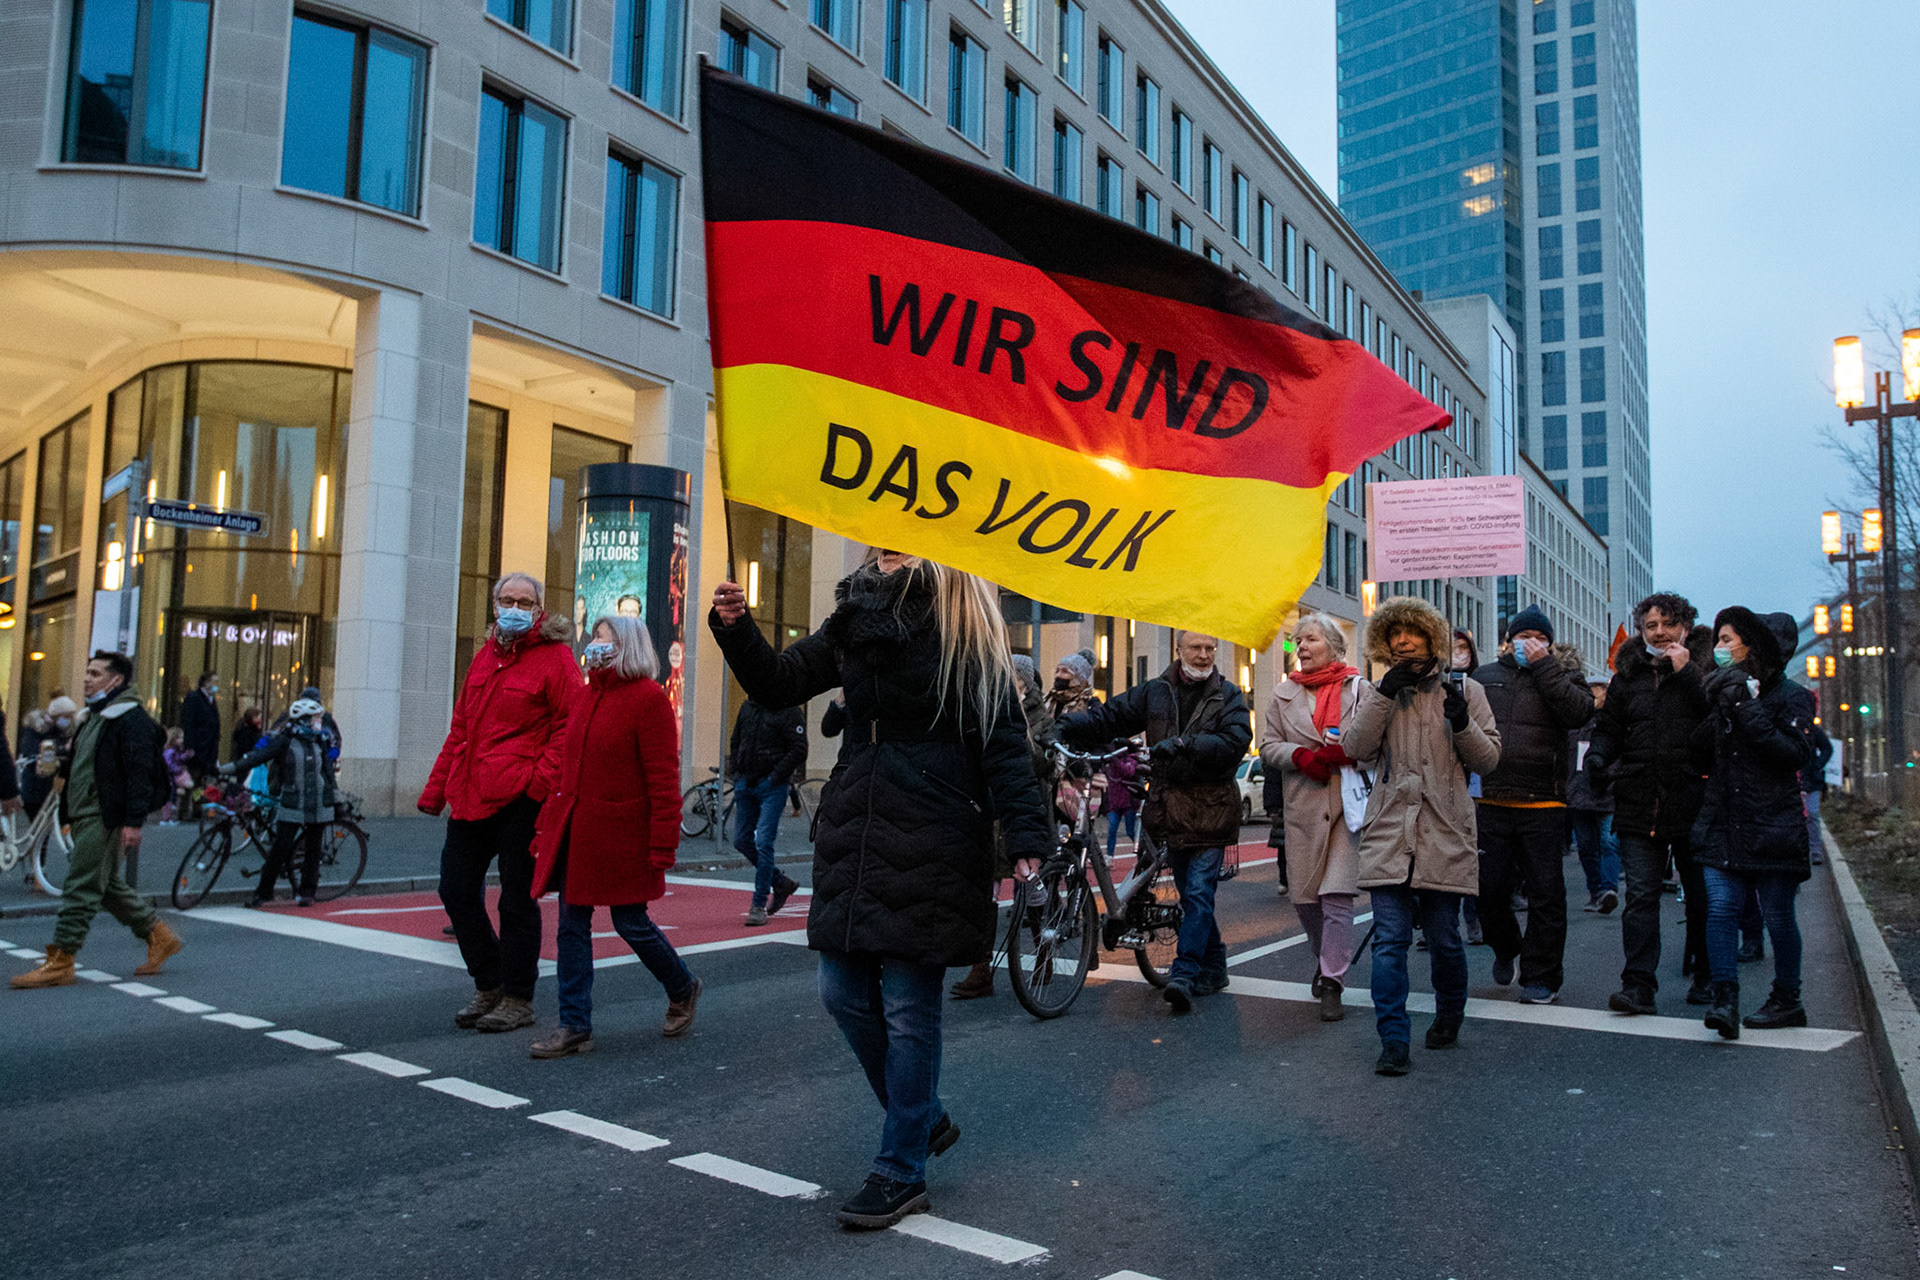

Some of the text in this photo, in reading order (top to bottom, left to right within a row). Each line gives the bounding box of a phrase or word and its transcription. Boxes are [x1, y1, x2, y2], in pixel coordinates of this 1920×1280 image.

[868, 274, 1270, 440] WIR SIND
[820, 422, 1176, 573] DAS VOLK
[152, 504, 258, 531] Bockenheimer Anlage
[1478, 513, 1521, 521] Schwangeren
[595, 545, 640, 562] FLOORS
[1479, 542, 1521, 550] Generationen
[1401, 555, 1451, 564] gentechnischen
[1454, 552, 1497, 560] Experimenten
